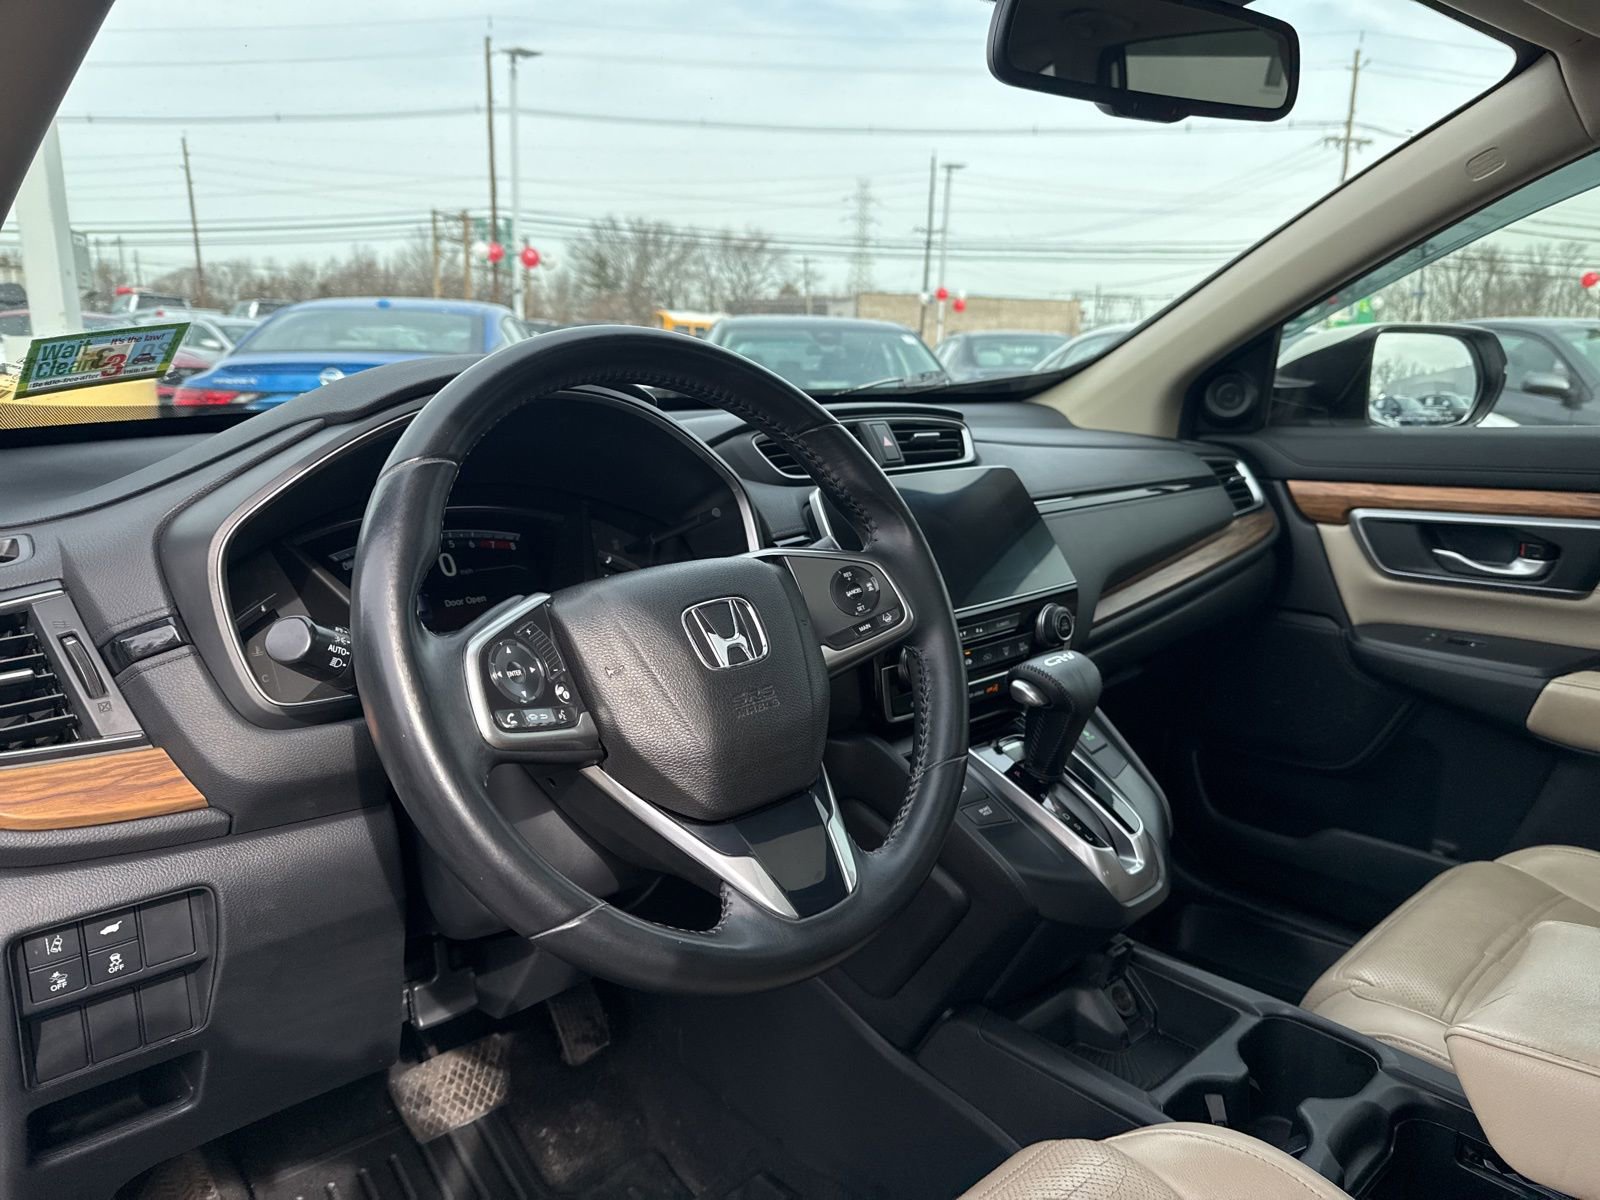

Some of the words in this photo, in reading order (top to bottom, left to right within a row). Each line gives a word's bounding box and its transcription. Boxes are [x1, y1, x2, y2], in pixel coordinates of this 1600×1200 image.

[41, 339, 93, 361] Wait
[100, 353, 127, 377] 3
[438, 552, 457, 577] 0
[444, 599, 464, 608] Door
[465, 595, 487, 605] Open
[328, 644, 347, 656] AUTO
[506, 669, 522, 678] ENTER
[108, 963, 125, 974] OFF
[50, 981, 67, 992] OFF
